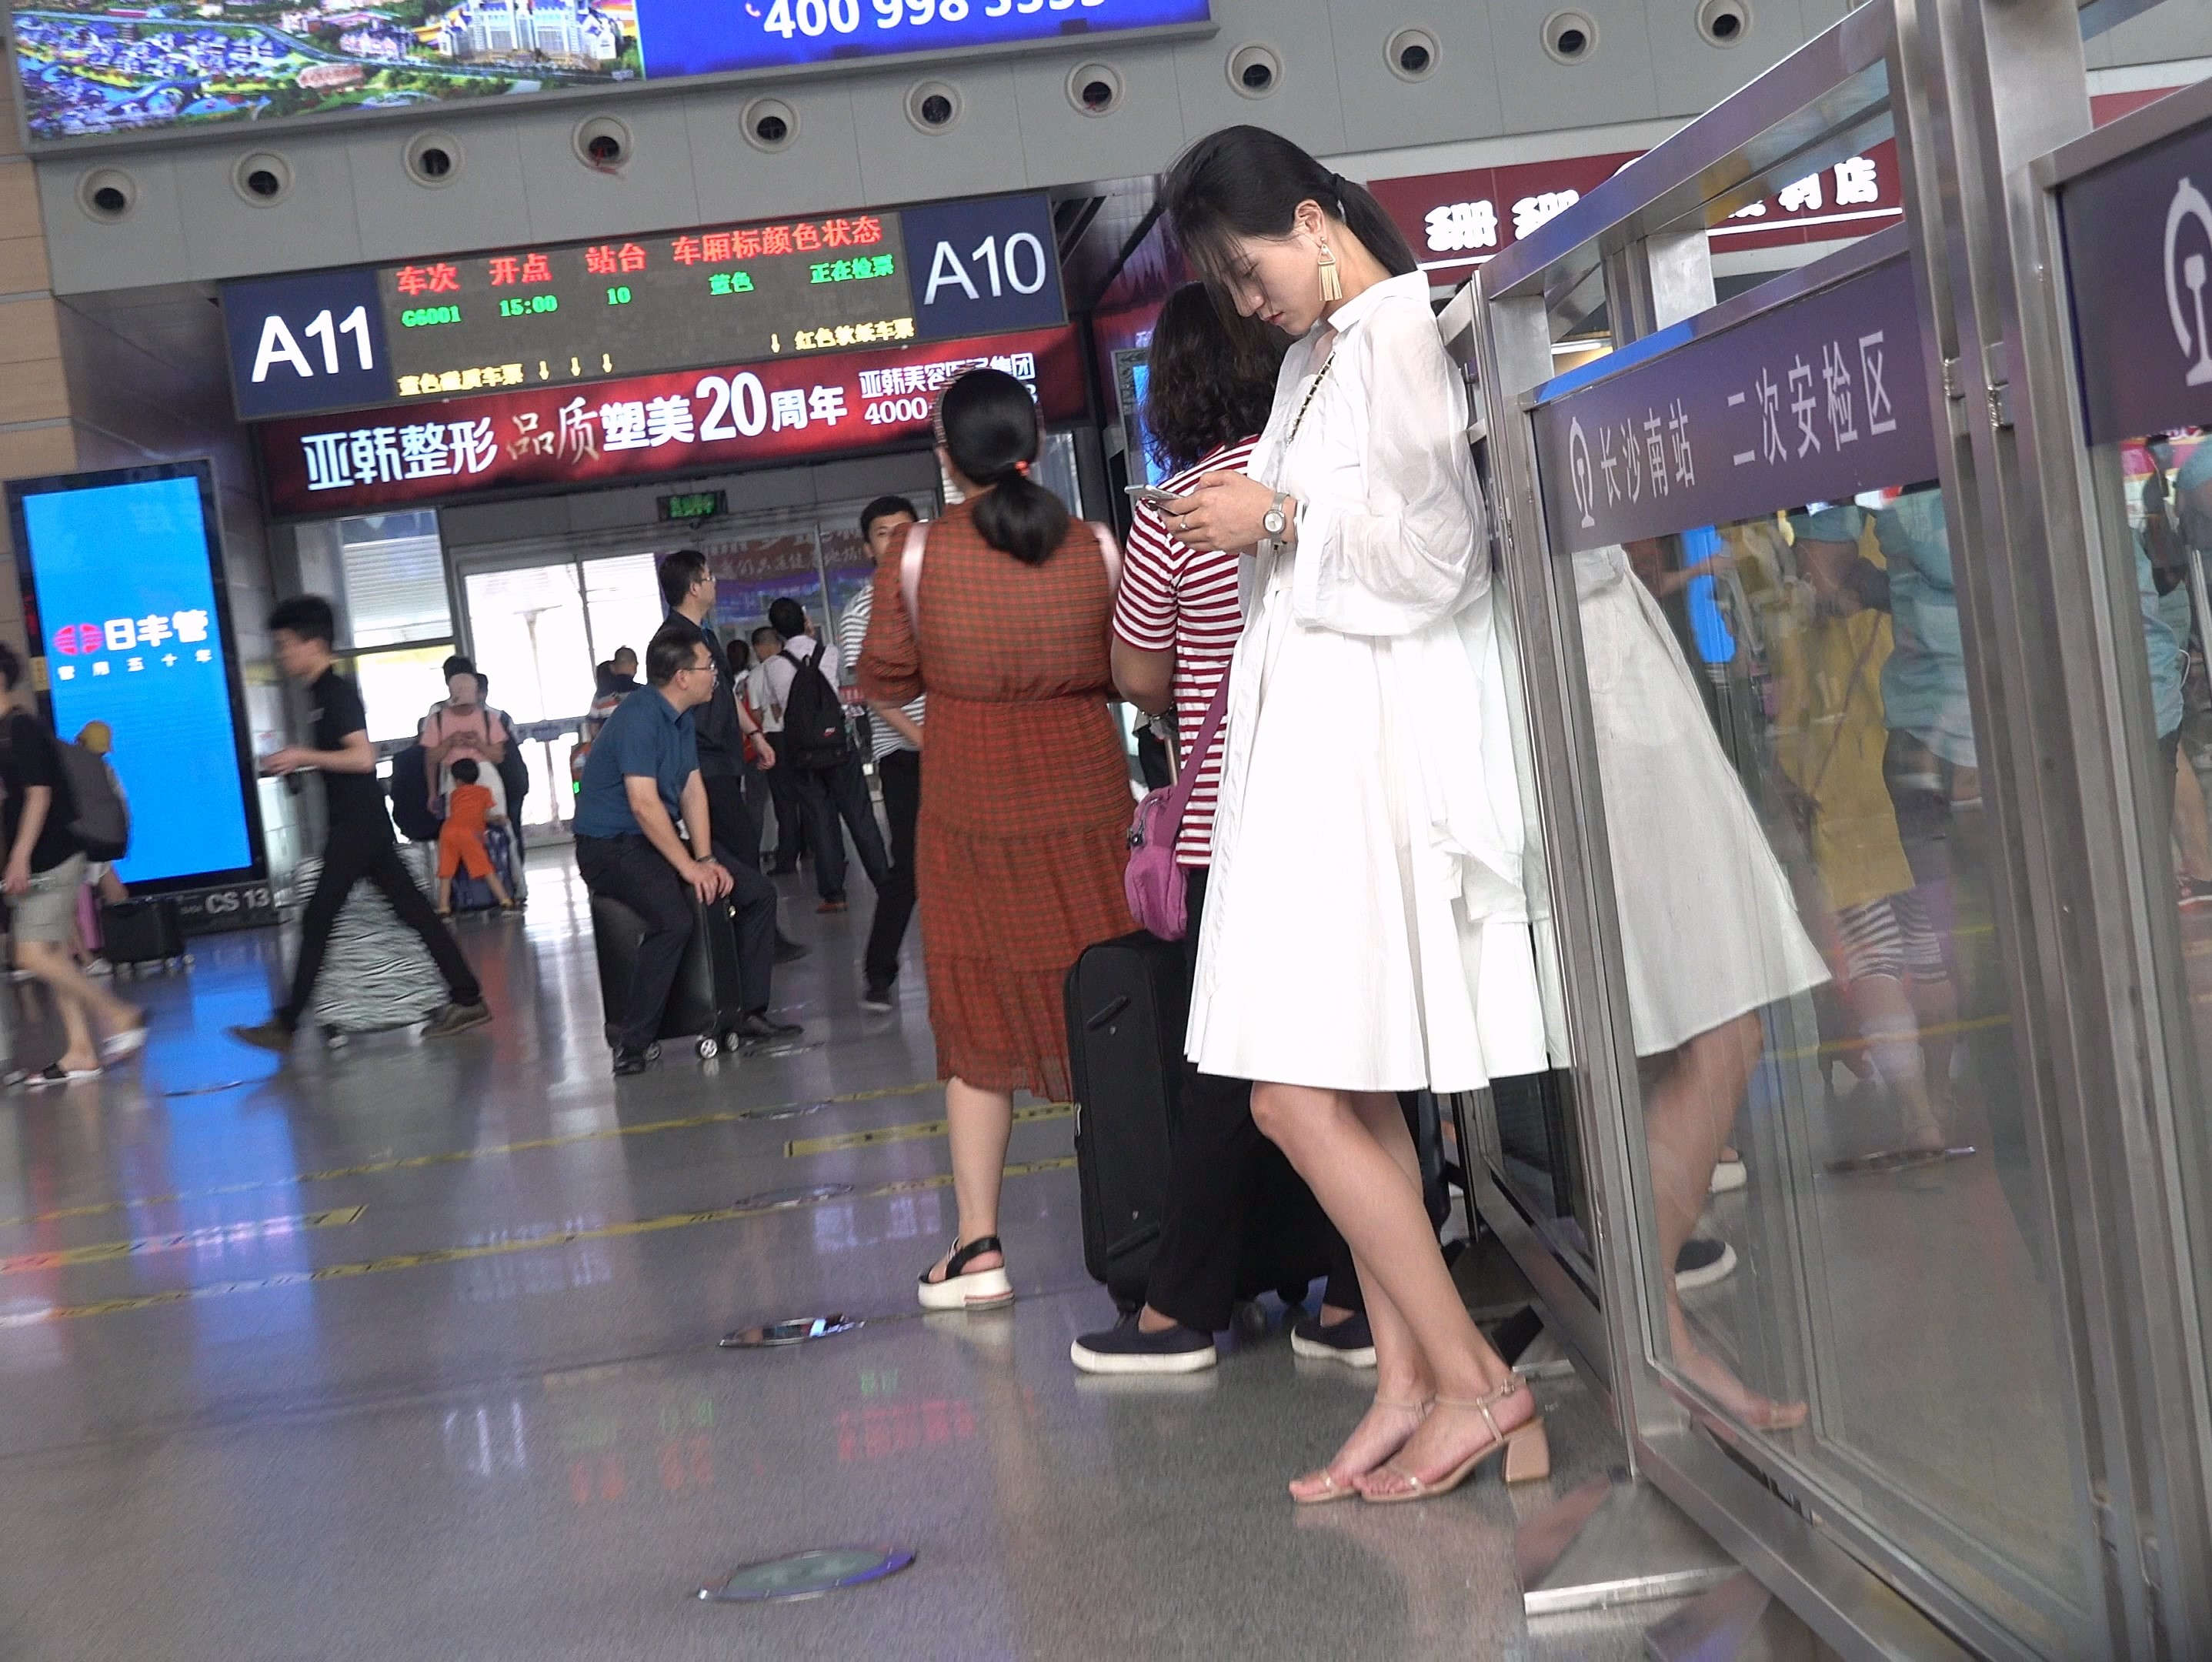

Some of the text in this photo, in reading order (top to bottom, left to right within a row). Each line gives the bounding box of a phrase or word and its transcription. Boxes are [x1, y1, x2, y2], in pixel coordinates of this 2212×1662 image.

[763, 0, 860, 38] 400
[396, 215, 882, 296] 车次 开点 站台 车厢标颜色状态
[499, 295, 559, 318] 15:00
[606, 285, 632, 305] 10
[709, 271, 755, 296] 蓝色
[809, 254, 895, 285] 正在检票
[923, 232, 1046, 305] A10
[251, 305, 374, 383] A11
[300, 416, 499, 491] 亚韩整形
[1599, 329, 1897, 509] 长沙南站 二次安检区
